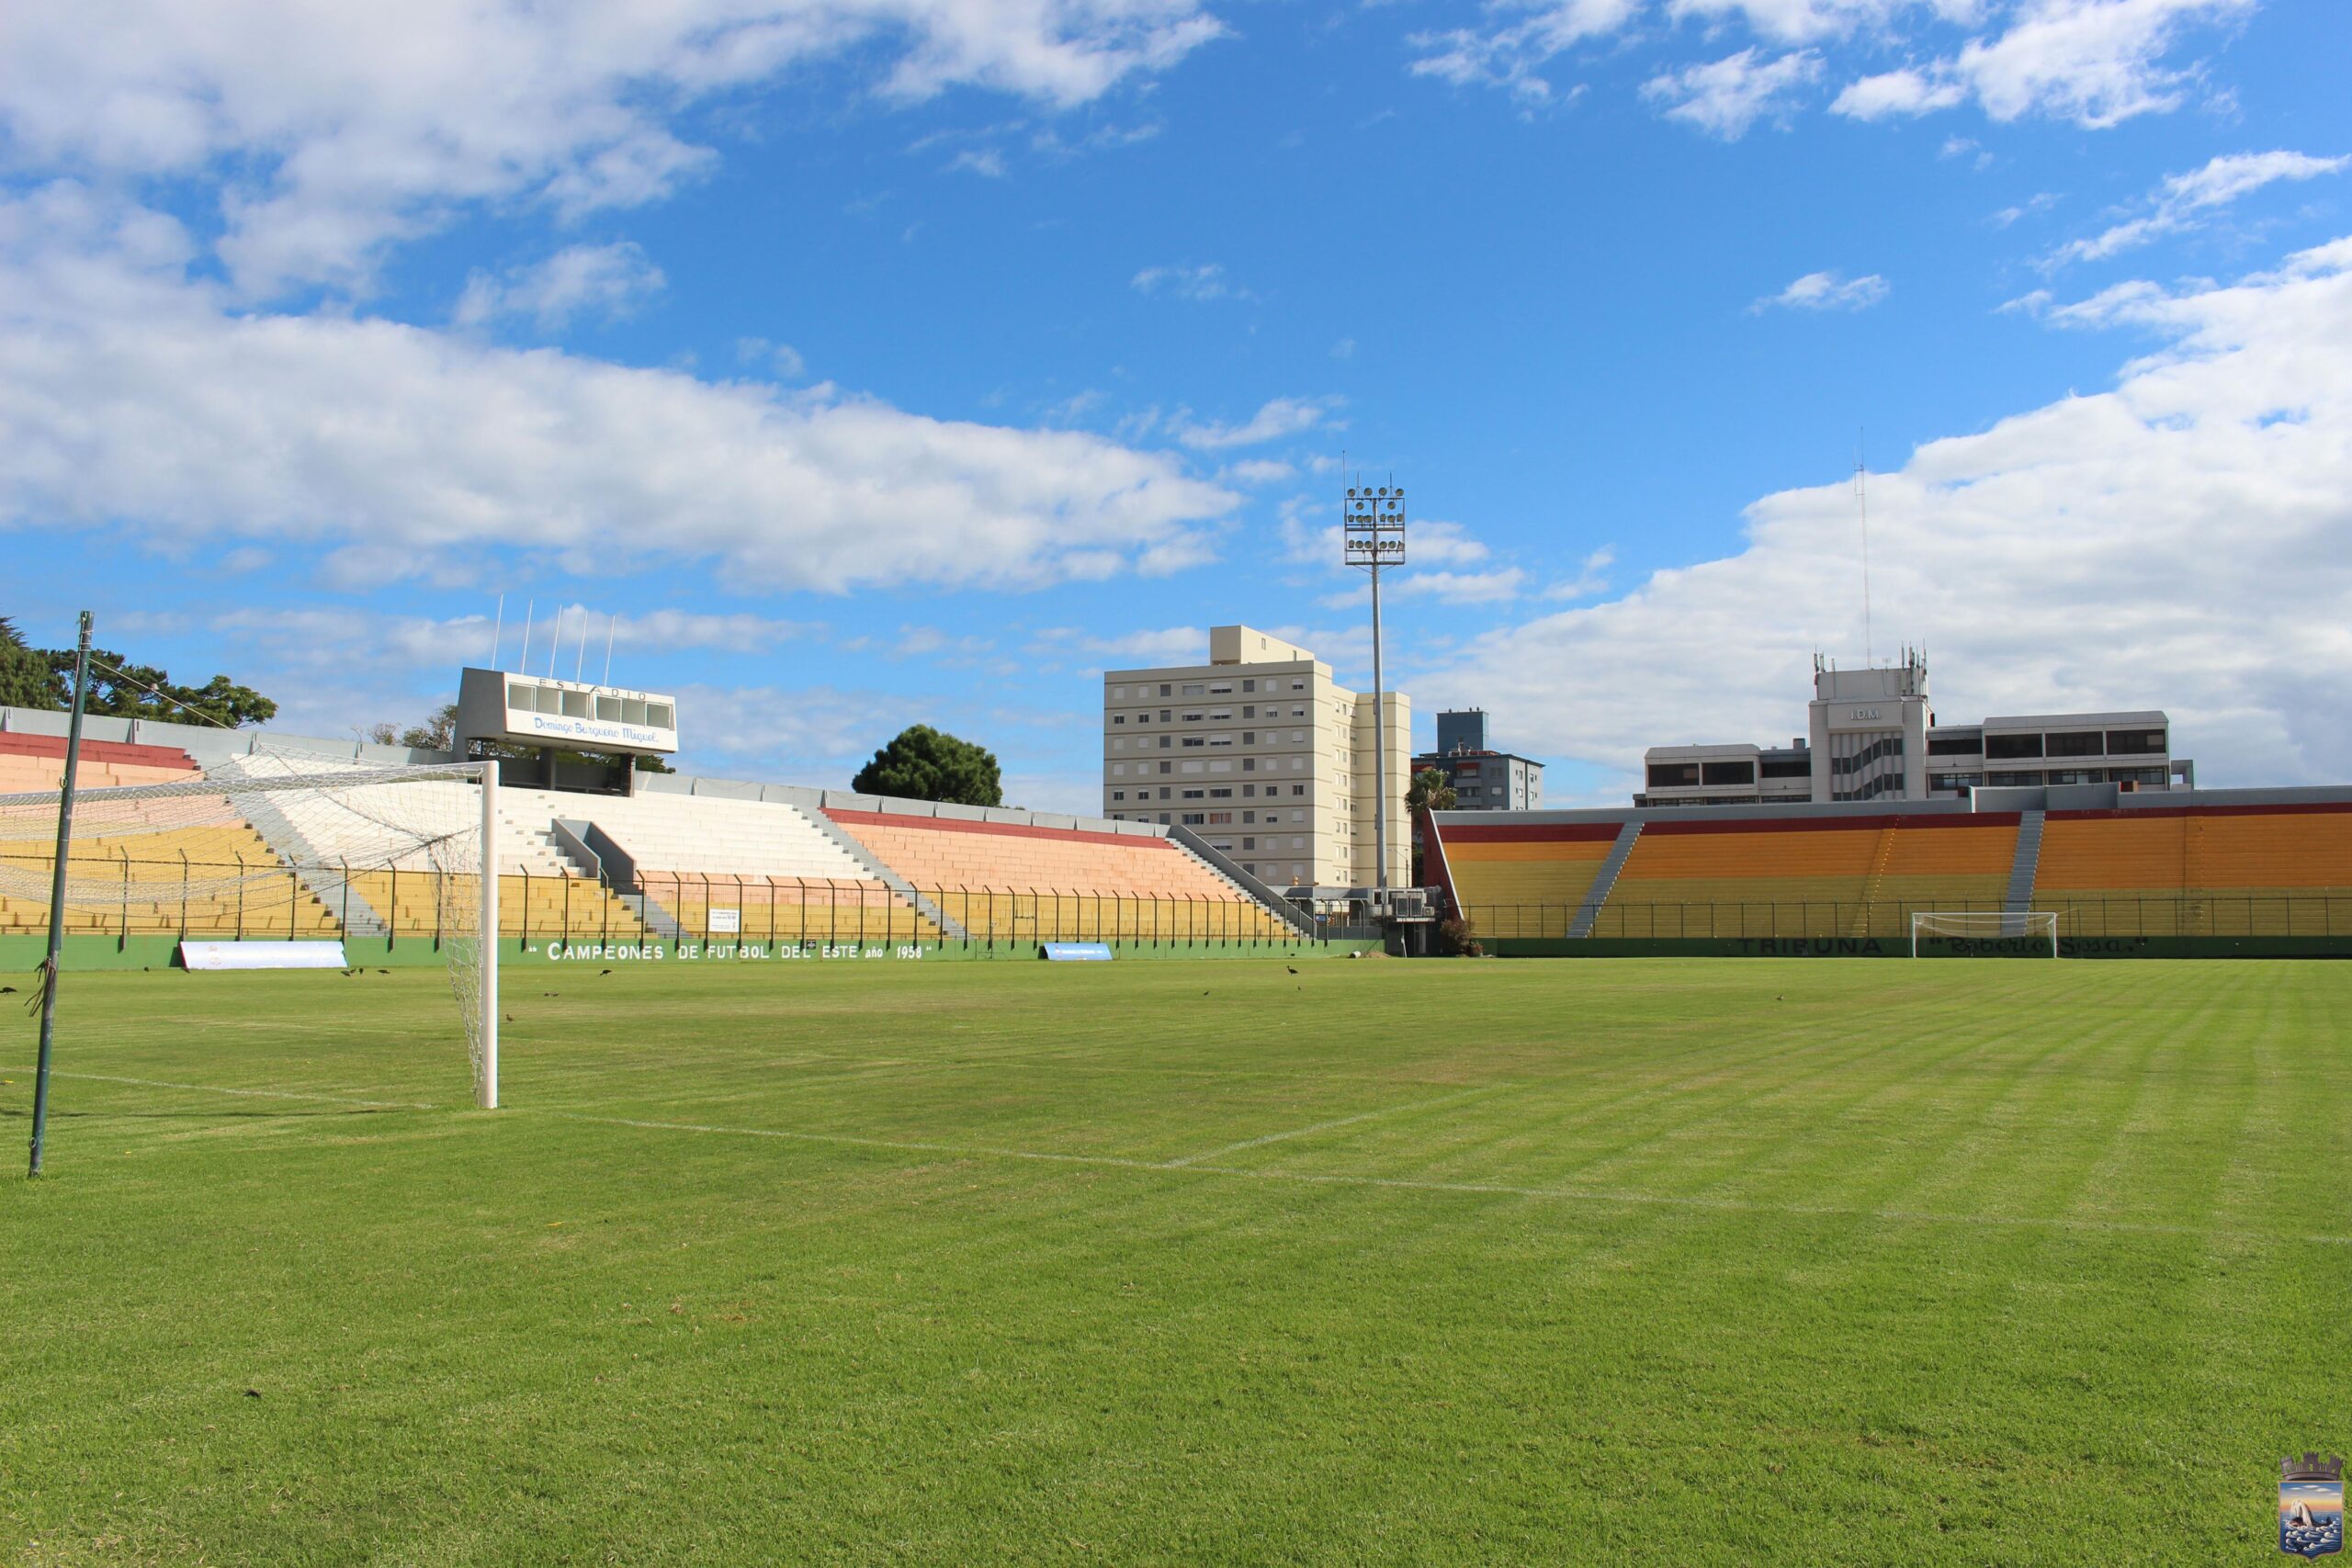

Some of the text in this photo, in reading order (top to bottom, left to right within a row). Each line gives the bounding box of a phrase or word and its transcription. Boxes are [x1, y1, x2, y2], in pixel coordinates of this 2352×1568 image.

[538, 678, 647, 701] ESTADIO
[534, 716, 574, 734] Domingo
[678, 945, 698, 959] DE
[707, 945, 770, 959] FUTBOL
[781, 945, 811, 958] DEL
[822, 945, 858, 958] ESTE
[865, 948, 884, 958] año
[1737, 939, 1883, 954] TRIBUNA
